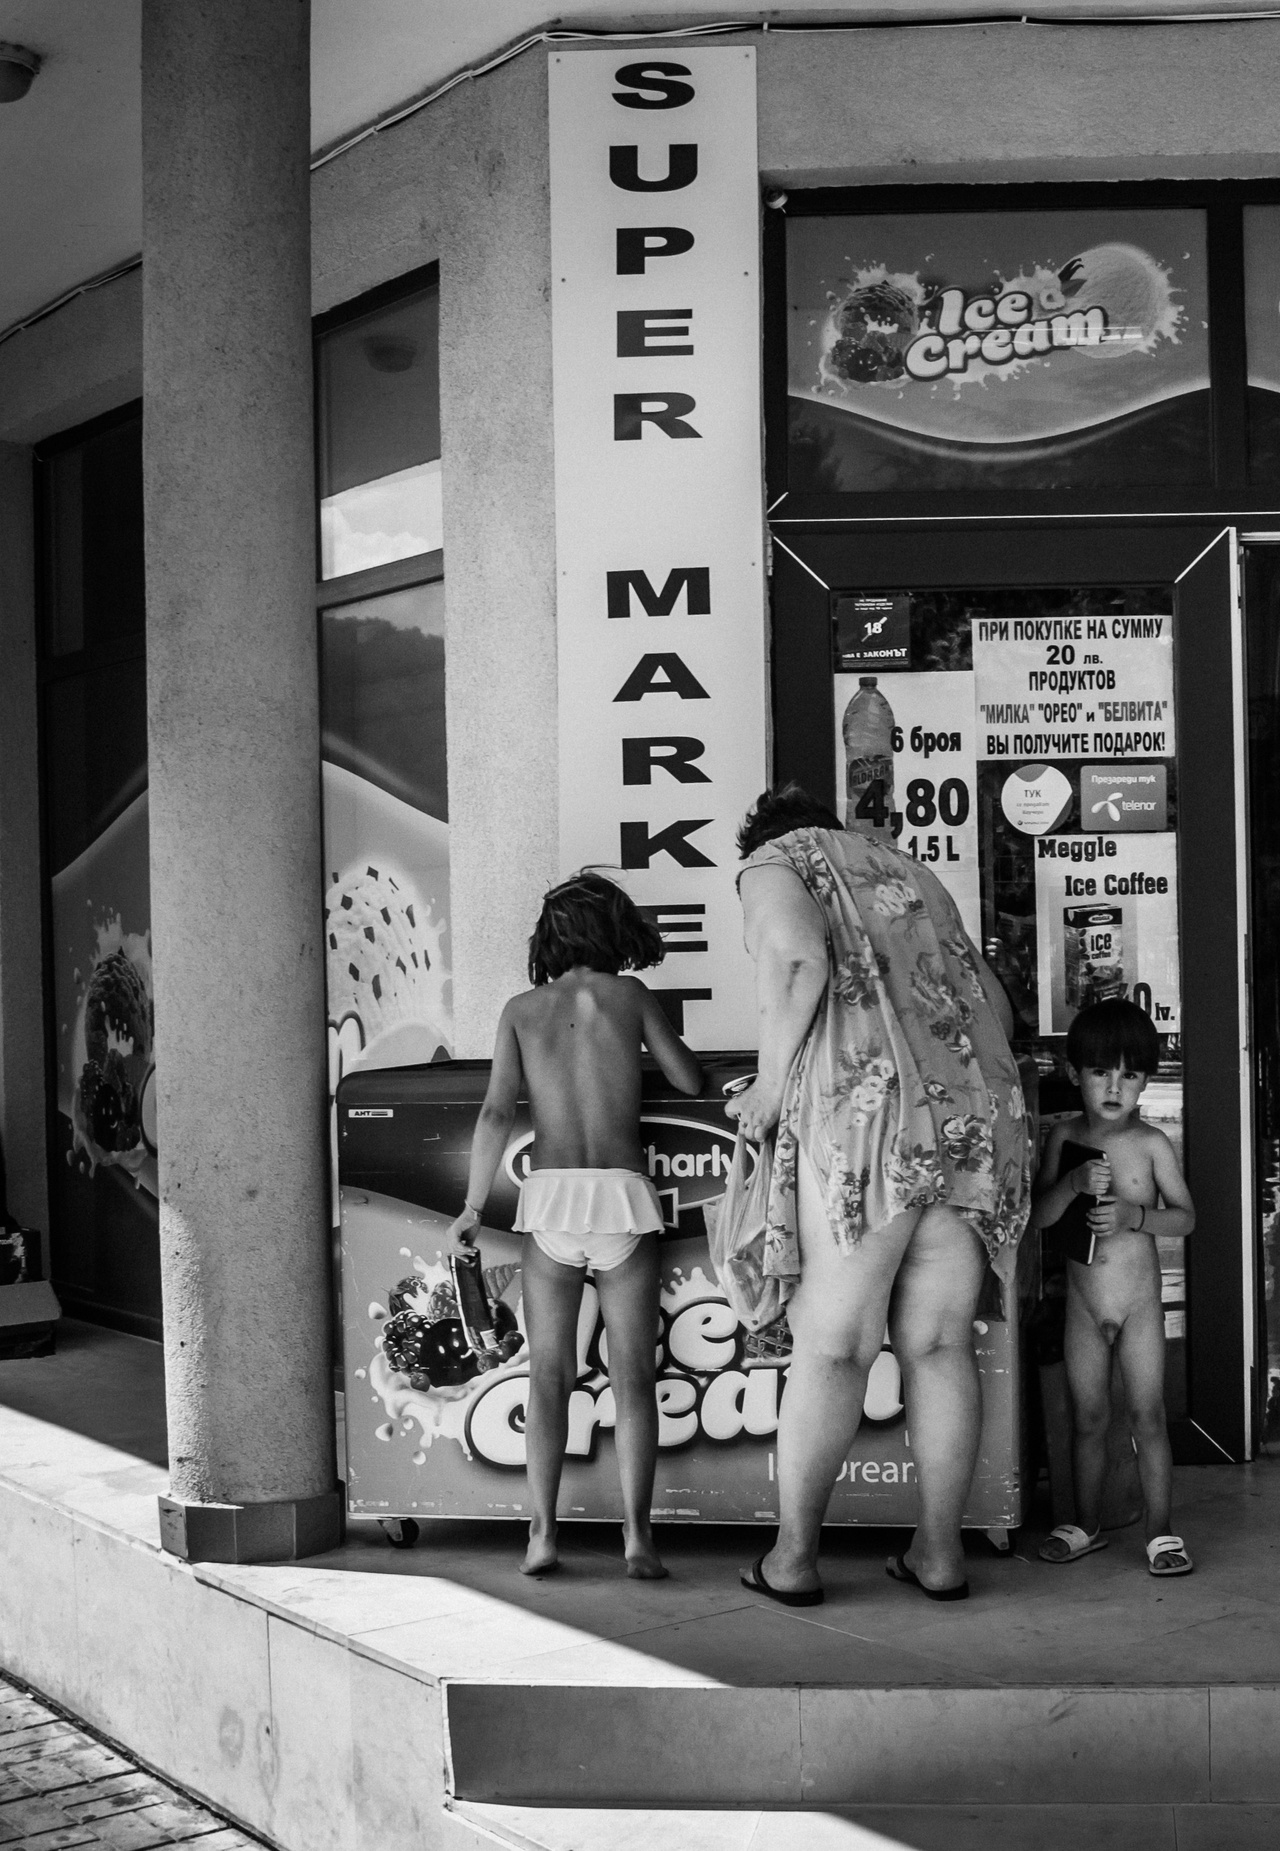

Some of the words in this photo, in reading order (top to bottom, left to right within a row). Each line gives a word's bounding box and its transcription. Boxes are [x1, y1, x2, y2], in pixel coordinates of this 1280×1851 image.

[609, 61, 704, 442] SUPER
[937, 287, 1031, 337] Ice
[978, 621, 1009, 641] ПРИ
[1013, 620, 1082, 641] ПОКУПКЕ
[1087, 619, 1108, 639] НА
[1112, 618, 1164, 639] СУММУ
[862, 648, 908, 658] ЗАКОНЪТ
[1045, 645, 1076, 666] 20
[1083, 652, 1104, 666] лв.
[1028, 669, 1117, 695] ПРОДУКТОВ
[980, 703, 1035, 725] "МИЛКА"
[1038, 702, 1084, 724] "ОРЕО"
[1086, 711, 1095, 722] и
[1098, 701, 1168, 723] "БЕЛВИТА"
[890, 727, 904, 753] 6
[910, 725, 962, 759] броя
[986, 736, 1010, 756] ВЫ
[1013, 734, 1090, 755] ПОЛУЧИТЕ
[1093, 732, 1166, 756] ПОДАРОК!
[605, 566, 719, 1037] MARKET
[1024, 789, 1041, 798] ТУК
[1121, 800, 1157, 811] telenor
[855, 778, 970, 839] 4,80
[947, 835, 960, 862] L
[1037, 836, 1118, 862] Meggle
[1064, 875, 1097, 897] Ice
[1104, 872, 1169, 896] Coffee
[1090, 933, 1112, 951] ice
[1155, 1002, 1176, 1021] lv.
